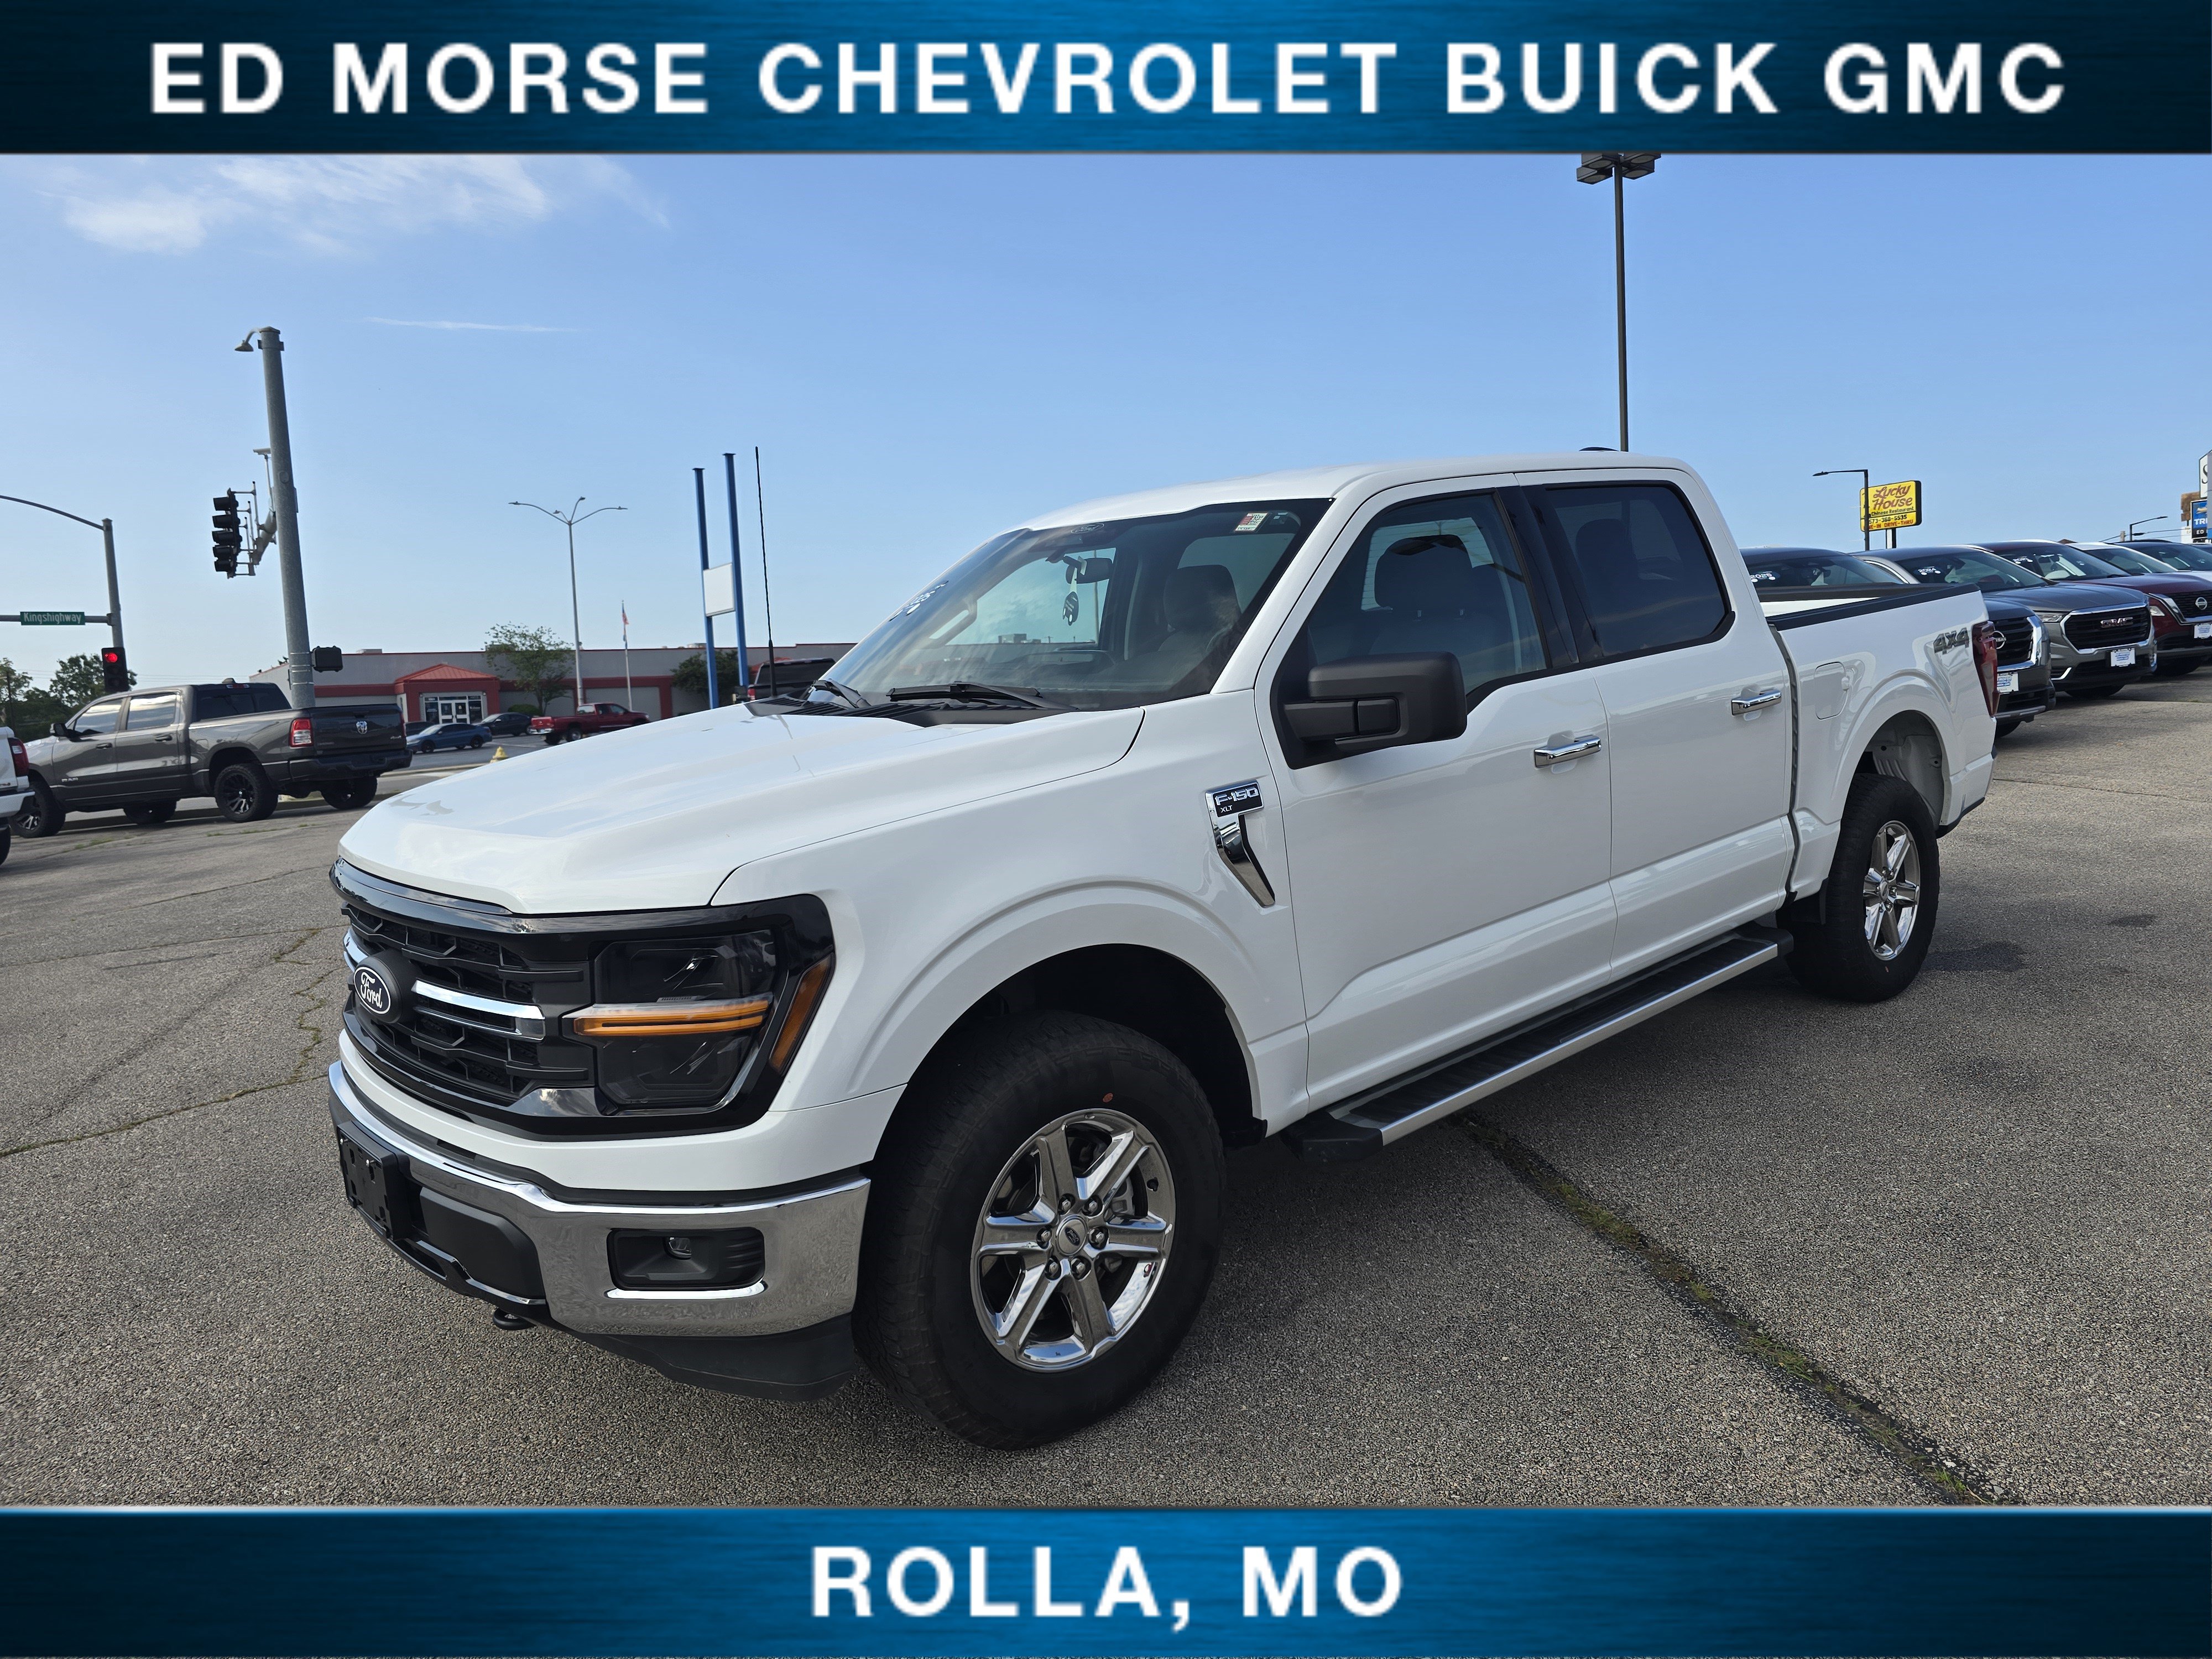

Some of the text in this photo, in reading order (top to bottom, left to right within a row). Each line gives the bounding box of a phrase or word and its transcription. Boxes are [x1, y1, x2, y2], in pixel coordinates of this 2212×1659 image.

[1873, 485, 1911, 499] Lucky
[24, 612, 81, 624] Kingshighway
[2100, 617, 2133, 628] GMC
[1215, 786, 1259, 806] F-150
[1220, 805, 1233, 813] XLT
[360, 972, 383, 1009] Ford
[1067, 1229, 1079, 1243] Ford
